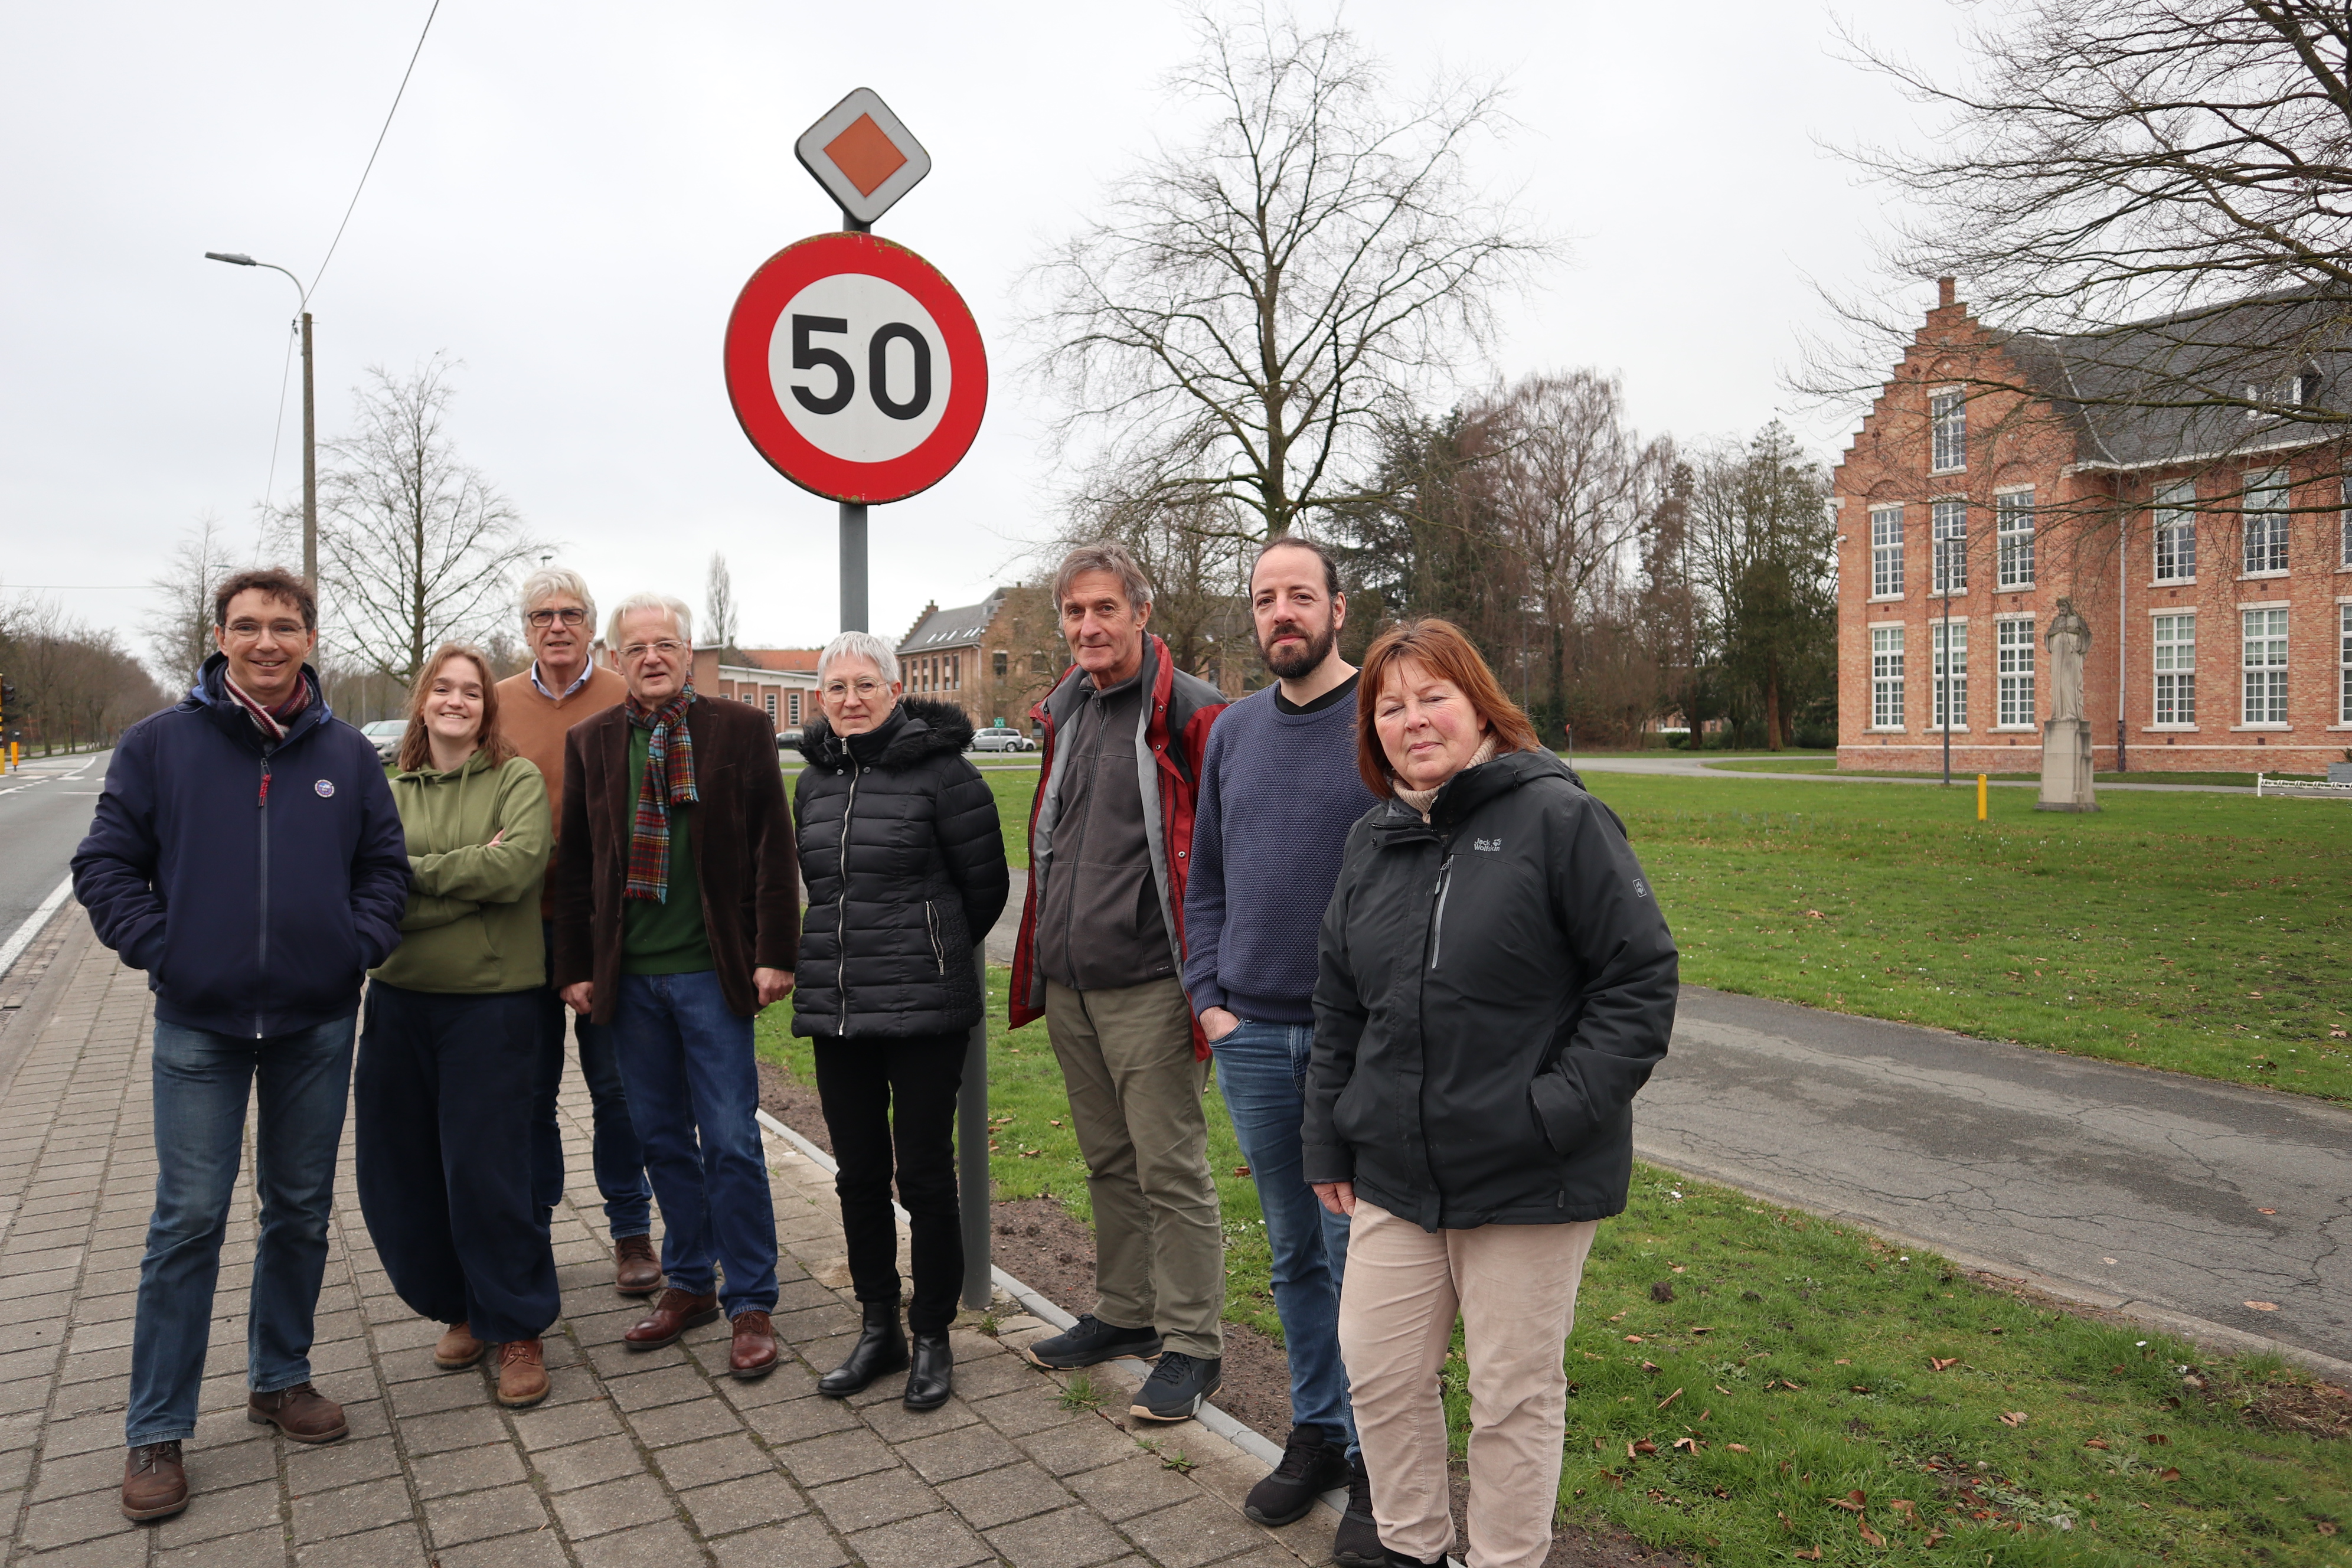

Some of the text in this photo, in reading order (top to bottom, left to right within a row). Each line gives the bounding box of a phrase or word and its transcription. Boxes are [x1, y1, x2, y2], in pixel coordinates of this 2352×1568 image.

[790, 313, 932, 420] 50
[1474, 837, 1491, 845] Jack
[1474, 844, 1500, 852] Wolfskin
